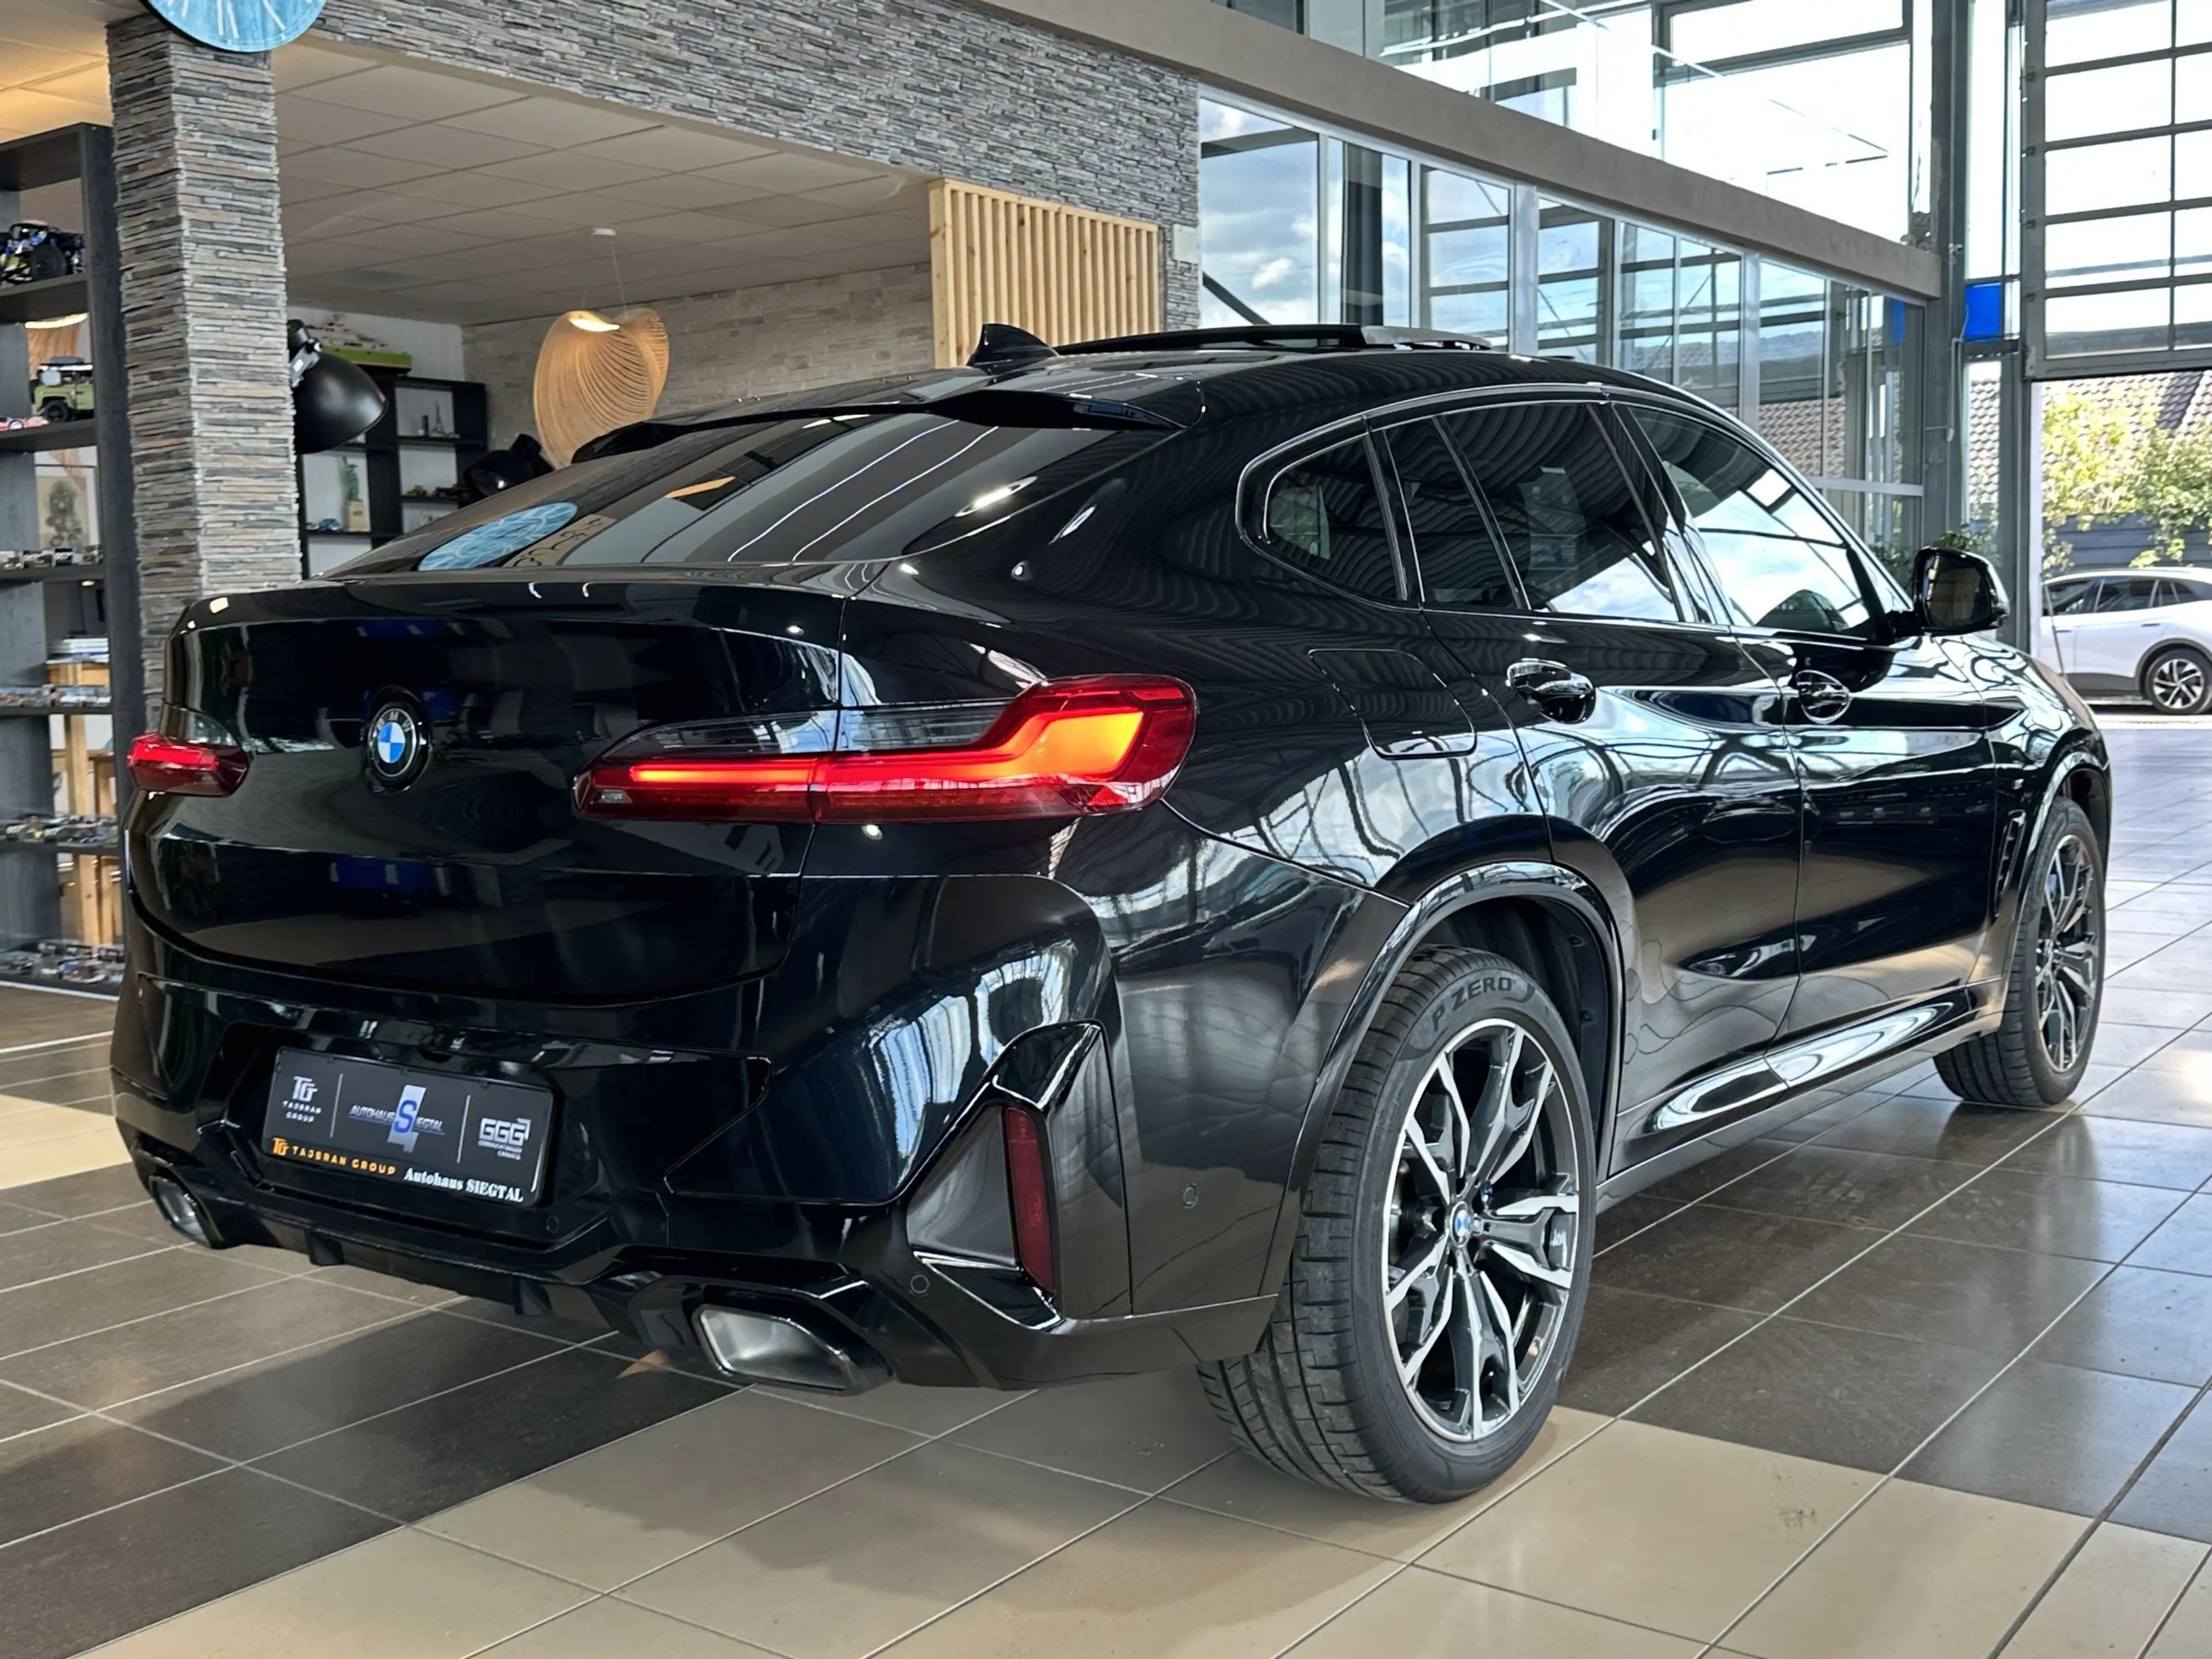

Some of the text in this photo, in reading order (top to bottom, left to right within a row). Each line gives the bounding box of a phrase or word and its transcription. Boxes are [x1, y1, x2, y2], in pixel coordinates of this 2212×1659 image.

[1432, 976, 1512, 1032] P ZERO
[292, 1146, 347, 1166] TAJERAN
[351, 1158, 396, 1175] GROUP
[403, 1167, 524, 1203] Autohaus SIEGTAL
